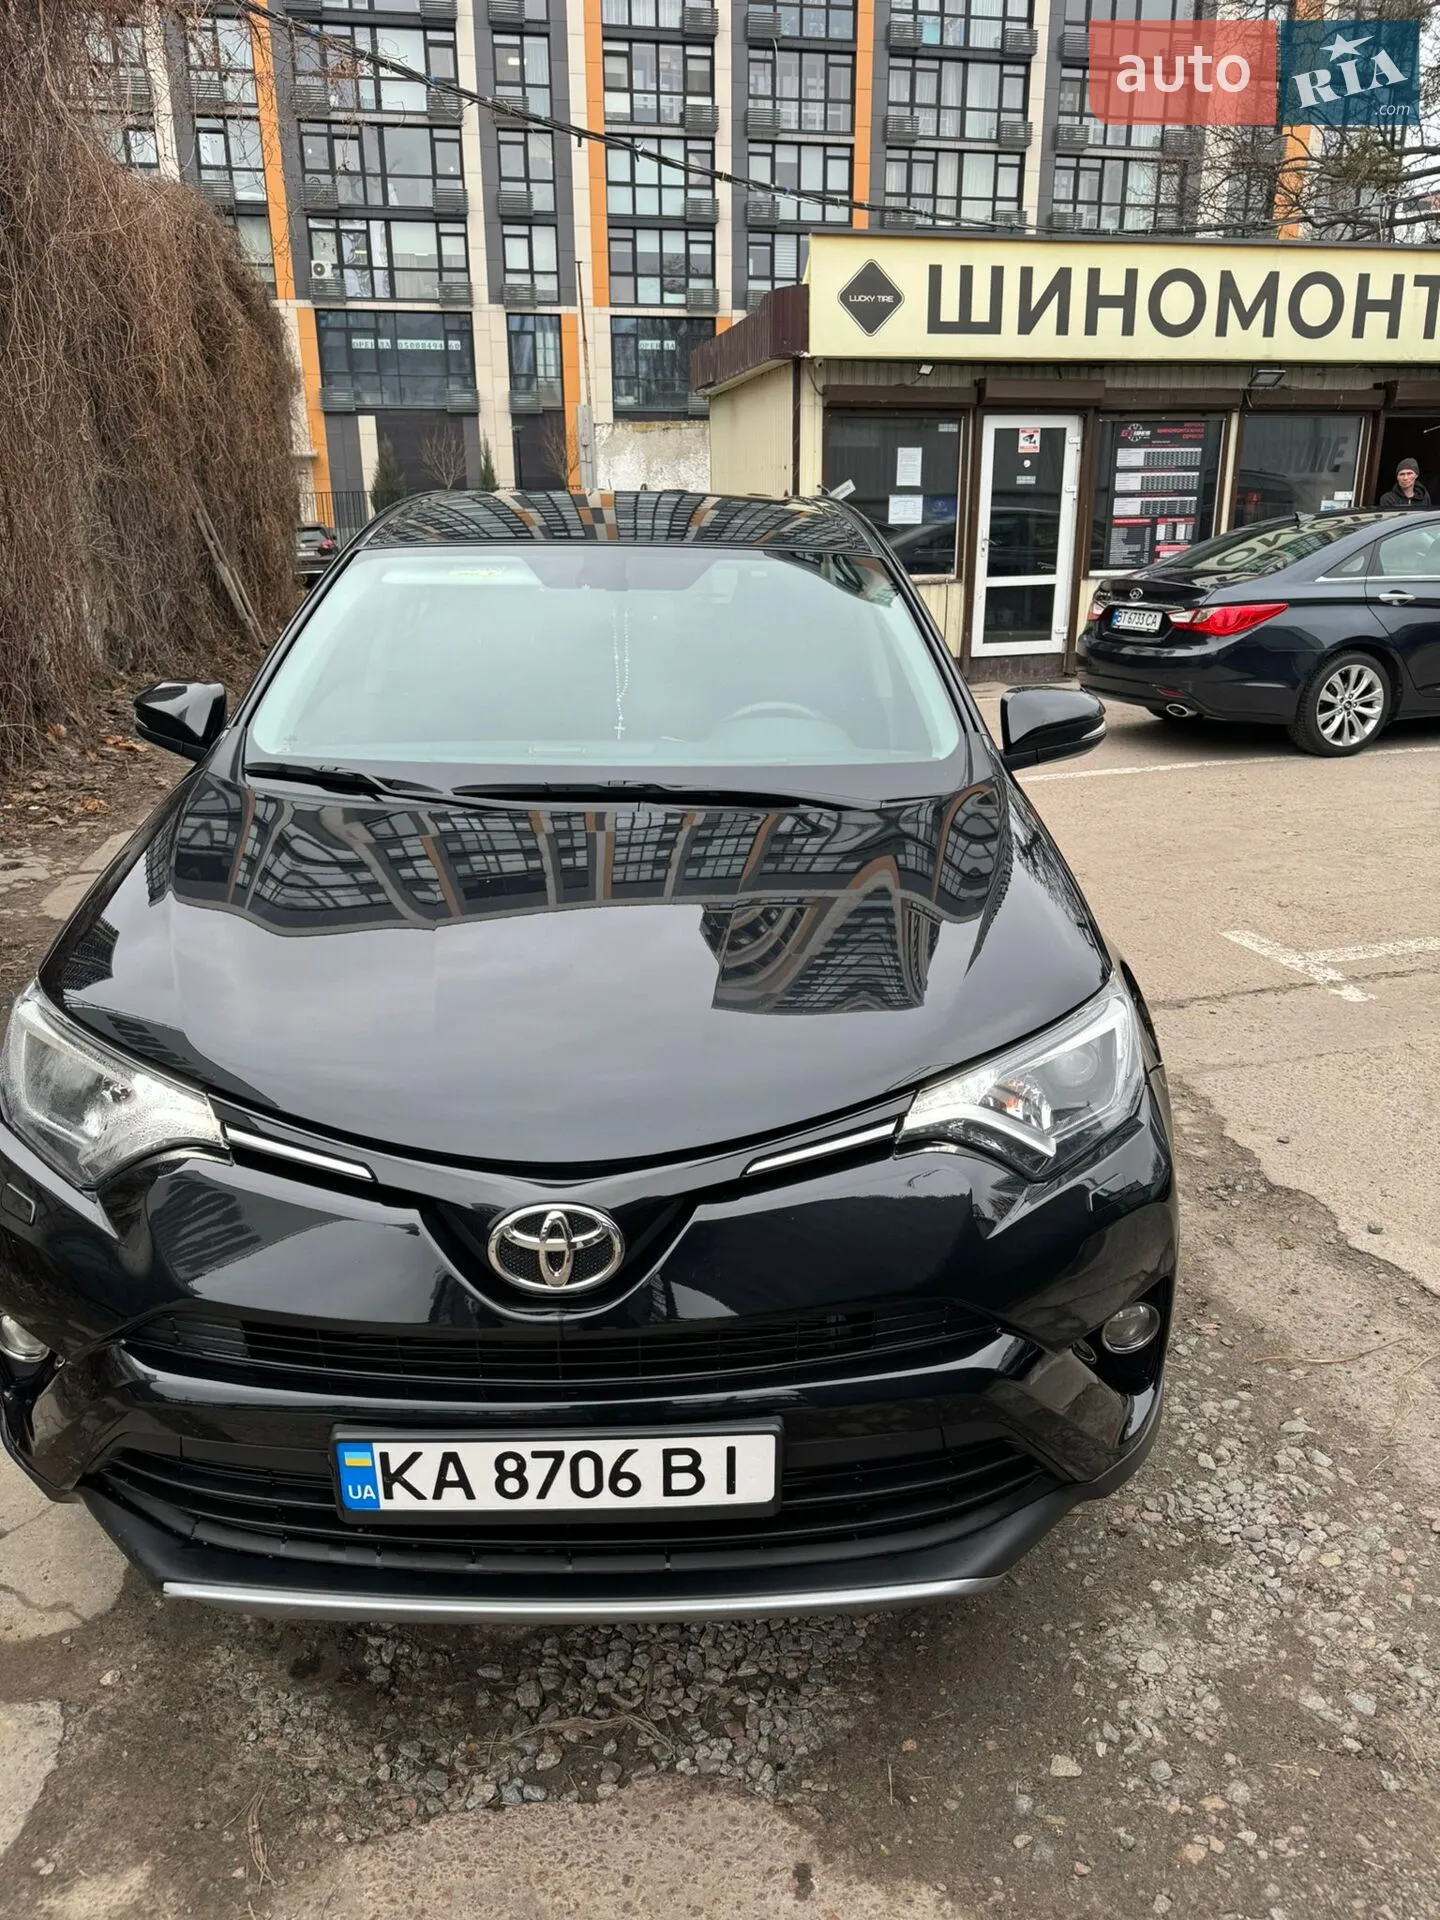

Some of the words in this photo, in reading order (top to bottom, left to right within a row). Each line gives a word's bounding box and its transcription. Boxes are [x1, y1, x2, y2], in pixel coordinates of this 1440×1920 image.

[848, 294, 876, 303] LUCKY
[876, 295, 895, 303] TIRE
[926, 263, 1440, 341] ШИНОМОНТ
[1145, 614, 1157, 627] CA
[379, 1450, 476, 1501] KA
[493, 1448, 642, 1501] 8706
[347, 1484, 377, 1500] UA
